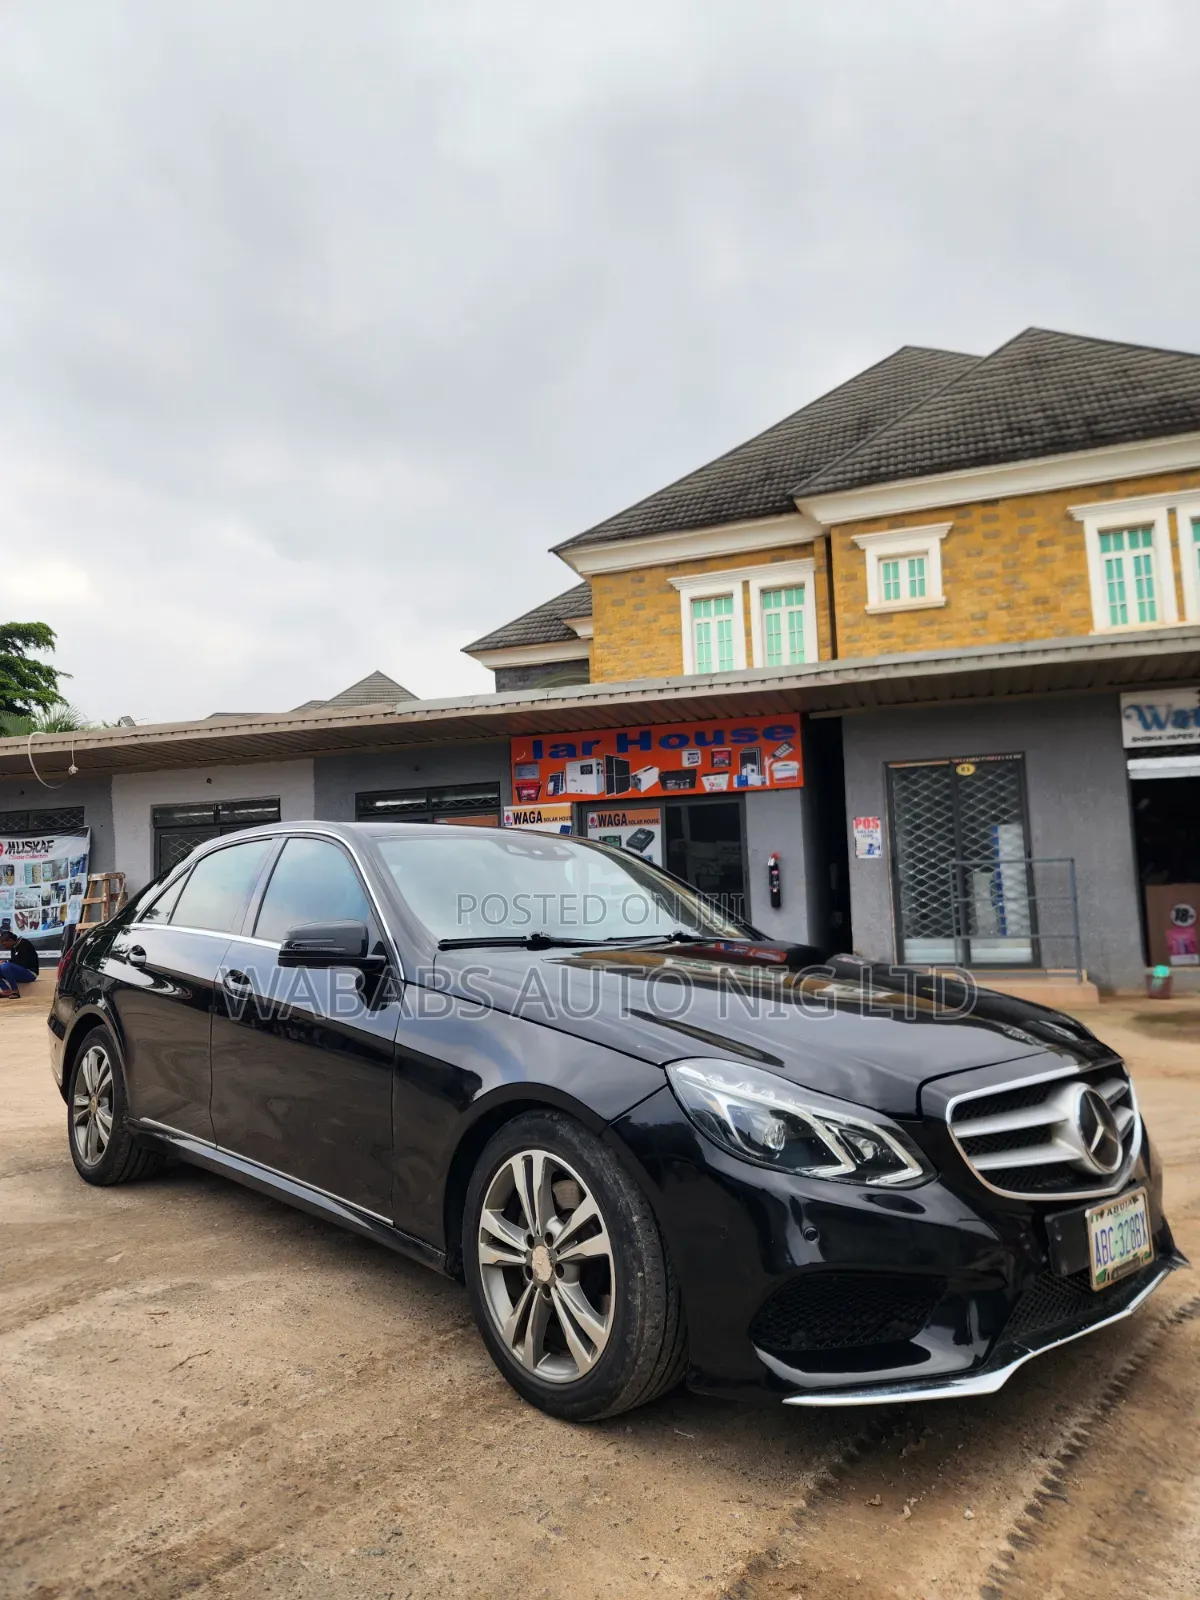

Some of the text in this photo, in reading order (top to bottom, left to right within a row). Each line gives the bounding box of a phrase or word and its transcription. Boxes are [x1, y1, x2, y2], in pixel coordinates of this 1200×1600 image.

[616, 724, 796, 754] House
[513, 810, 543, 825] WAGA
[597, 812, 628, 827] WAGA
[855, 817, 879, 829] POS
[5, 839, 54, 855] MUSKAF
[1174, 907, 1194, 922] 18+
